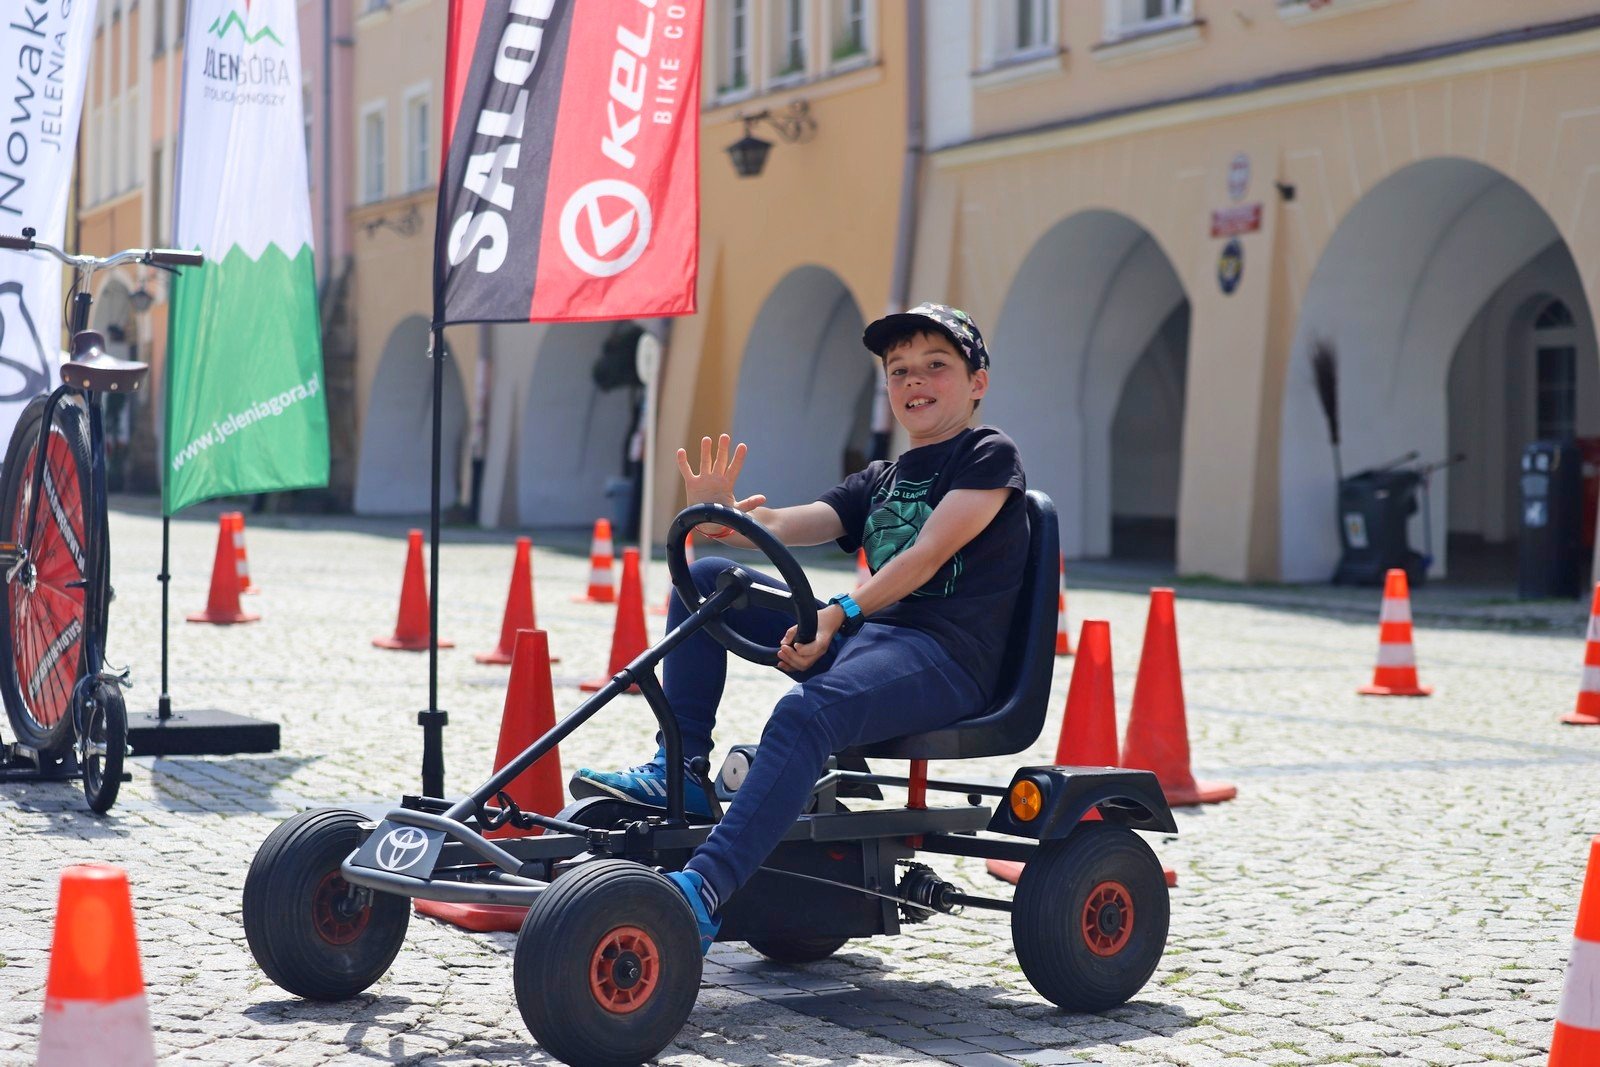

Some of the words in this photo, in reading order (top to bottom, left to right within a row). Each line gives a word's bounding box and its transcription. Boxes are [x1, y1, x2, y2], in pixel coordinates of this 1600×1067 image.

[0, 0, 49, 215] Nowak
[41, 31, 67, 152] JELENIA
[448, 0, 553, 274] SALO
[653, 57, 681, 125] BIKE
[171, 371, 321, 472] www.jeleniagora.pl
